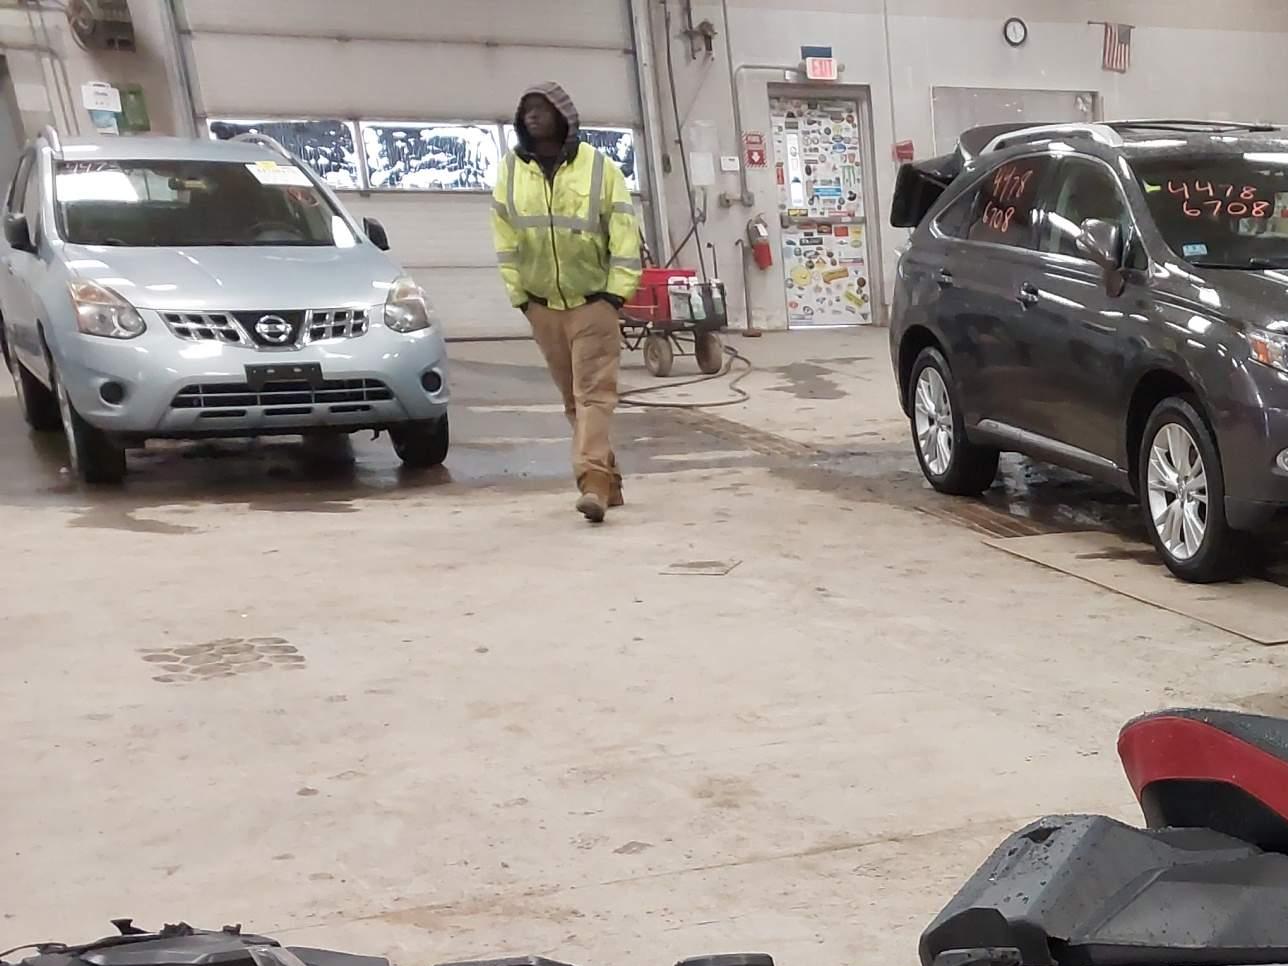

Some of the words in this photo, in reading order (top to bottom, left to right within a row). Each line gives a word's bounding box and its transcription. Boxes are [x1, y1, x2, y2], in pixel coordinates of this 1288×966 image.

[1167, 180, 1257, 199] 4478
[982, 201, 1015, 233] 6708
[1183, 200, 1271, 217] 6708
